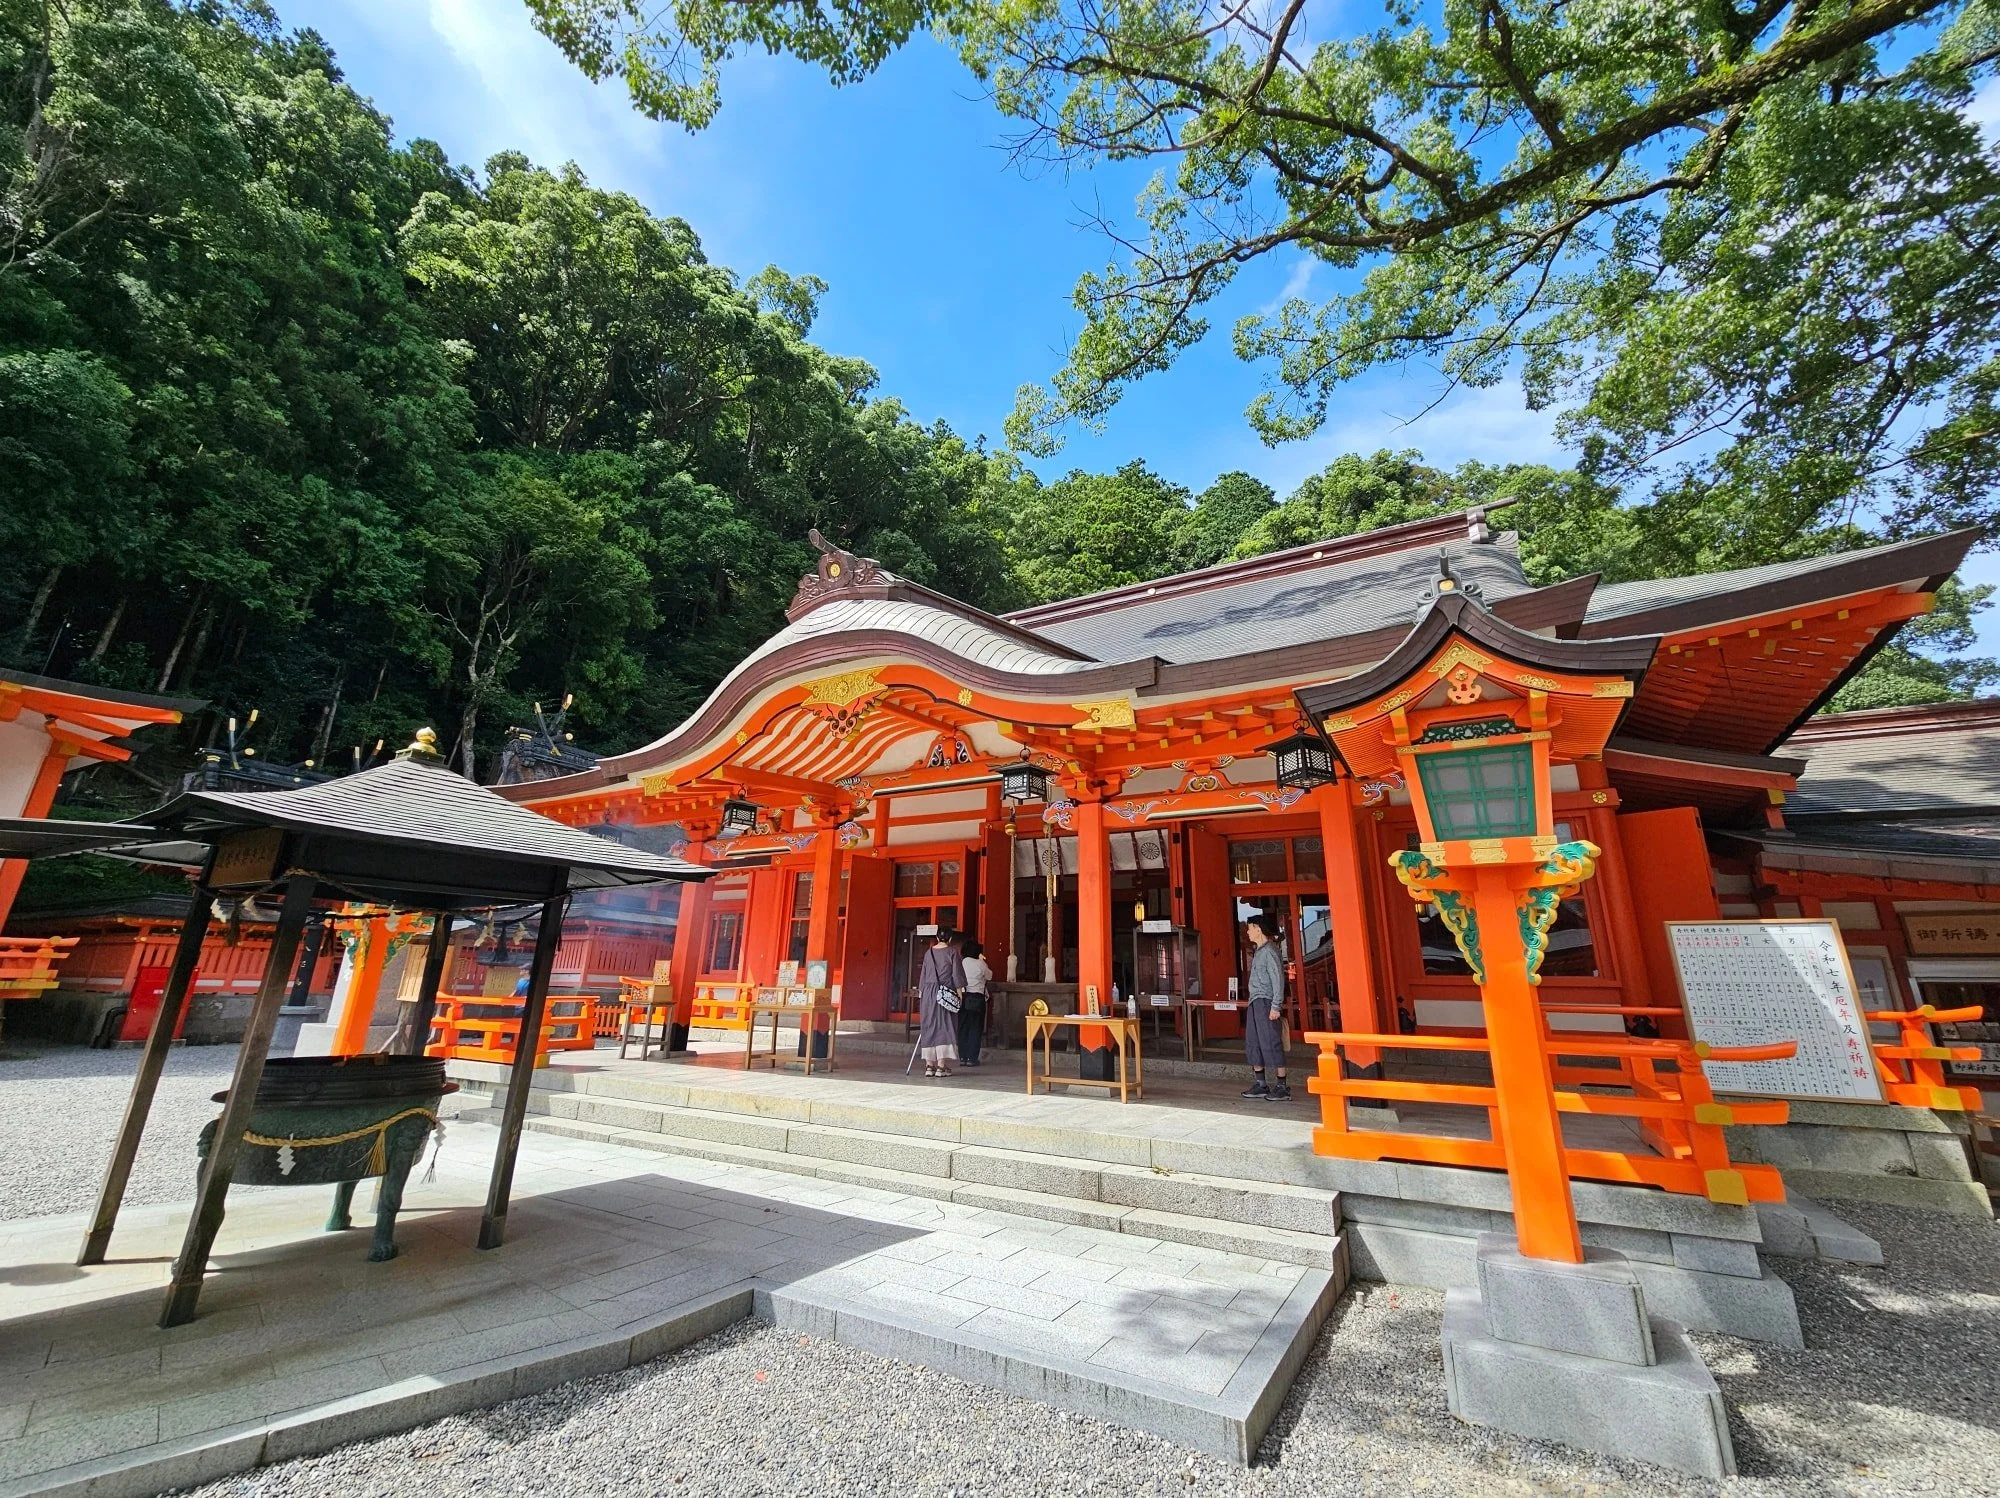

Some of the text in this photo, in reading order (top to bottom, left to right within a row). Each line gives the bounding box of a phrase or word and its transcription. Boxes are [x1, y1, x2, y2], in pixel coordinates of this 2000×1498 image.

[1917, 928, 1989, 940] 御祈祷
[1819, 940, 1869, 1080] 令和七年厄年及寿祈祷
